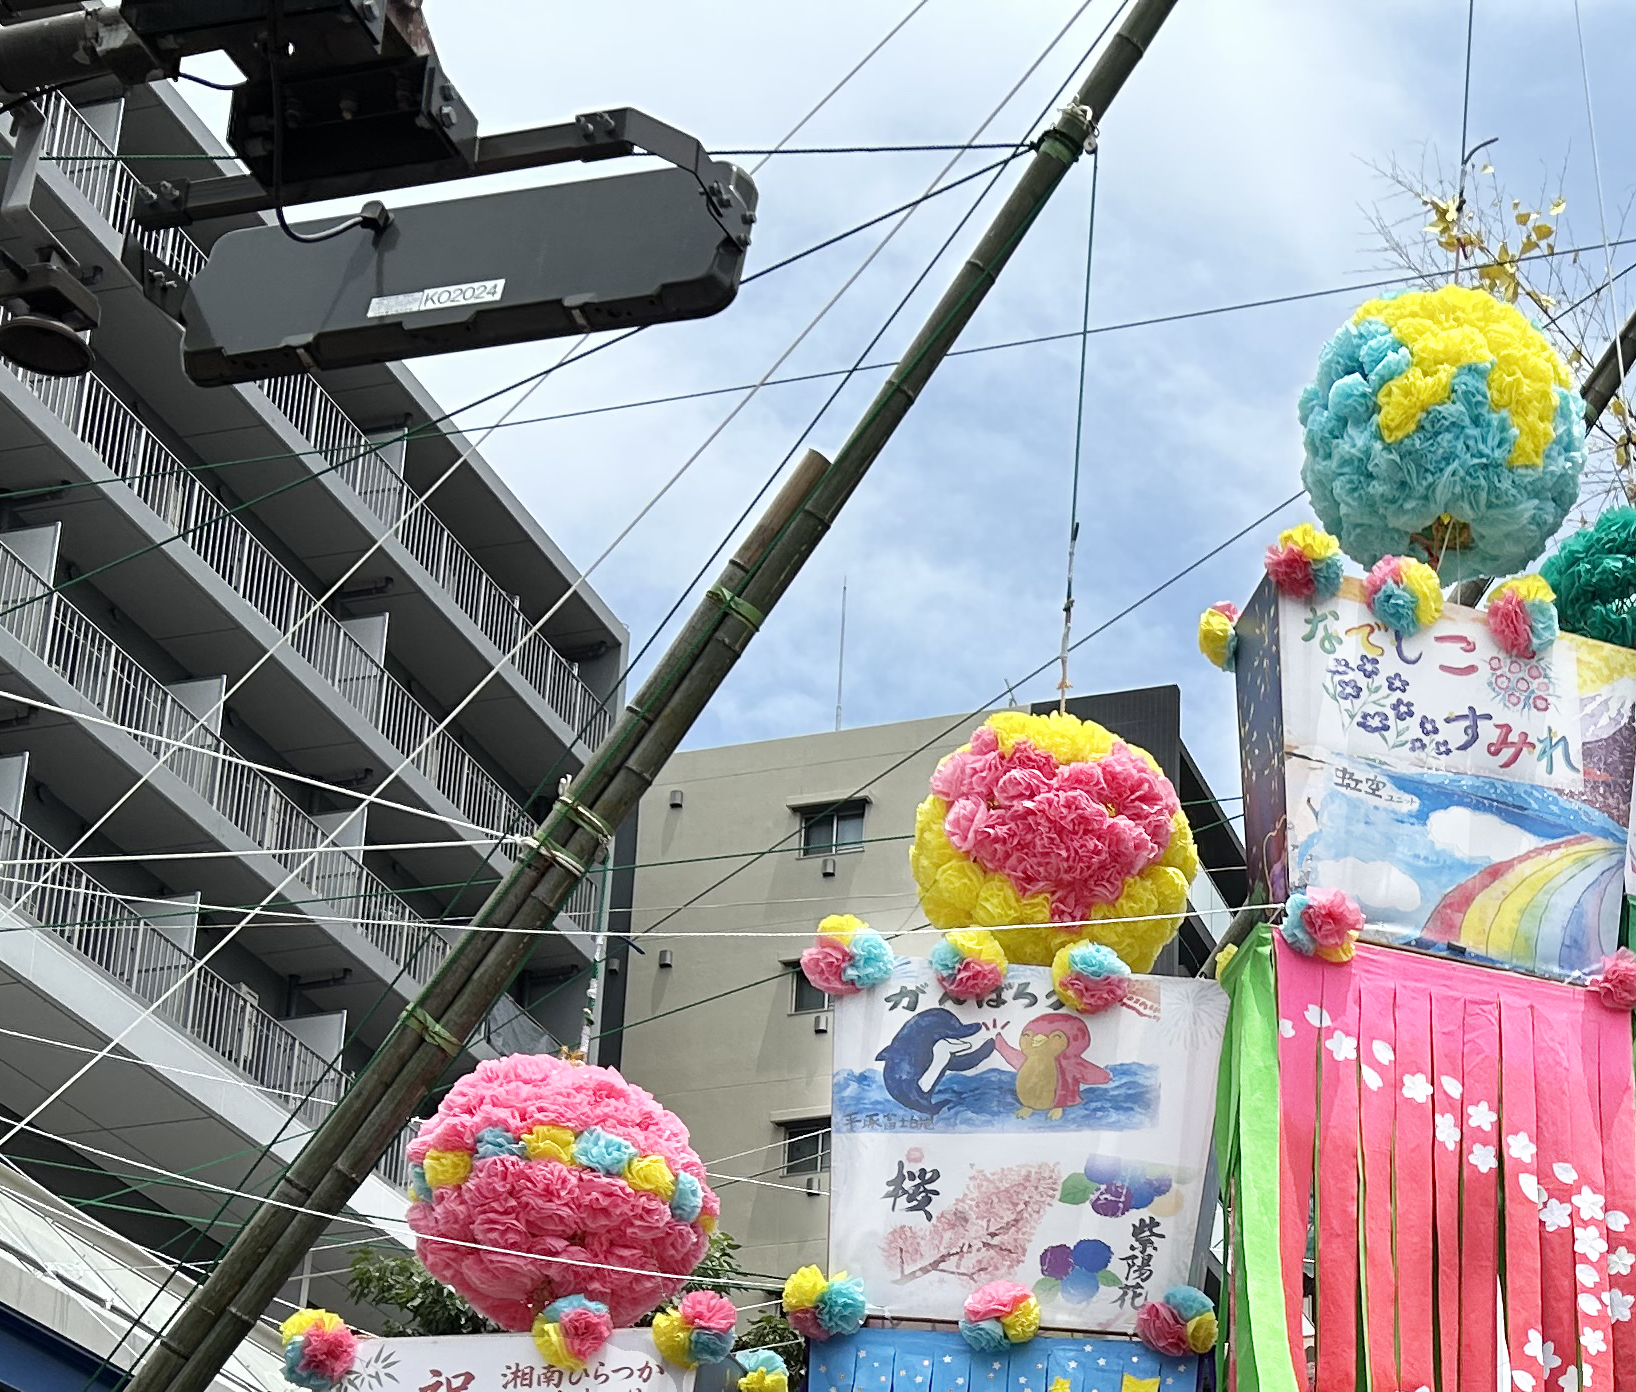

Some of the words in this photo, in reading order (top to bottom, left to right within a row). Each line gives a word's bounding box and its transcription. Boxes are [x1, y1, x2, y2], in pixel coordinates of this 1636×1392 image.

[1444, 704, 1580, 776] すみれ
[880, 1160, 941, 1222] 桜
[1111, 1215, 1167, 1310] 紫陽花
[500, 1360, 665, 1391] 湘南ひらつか
